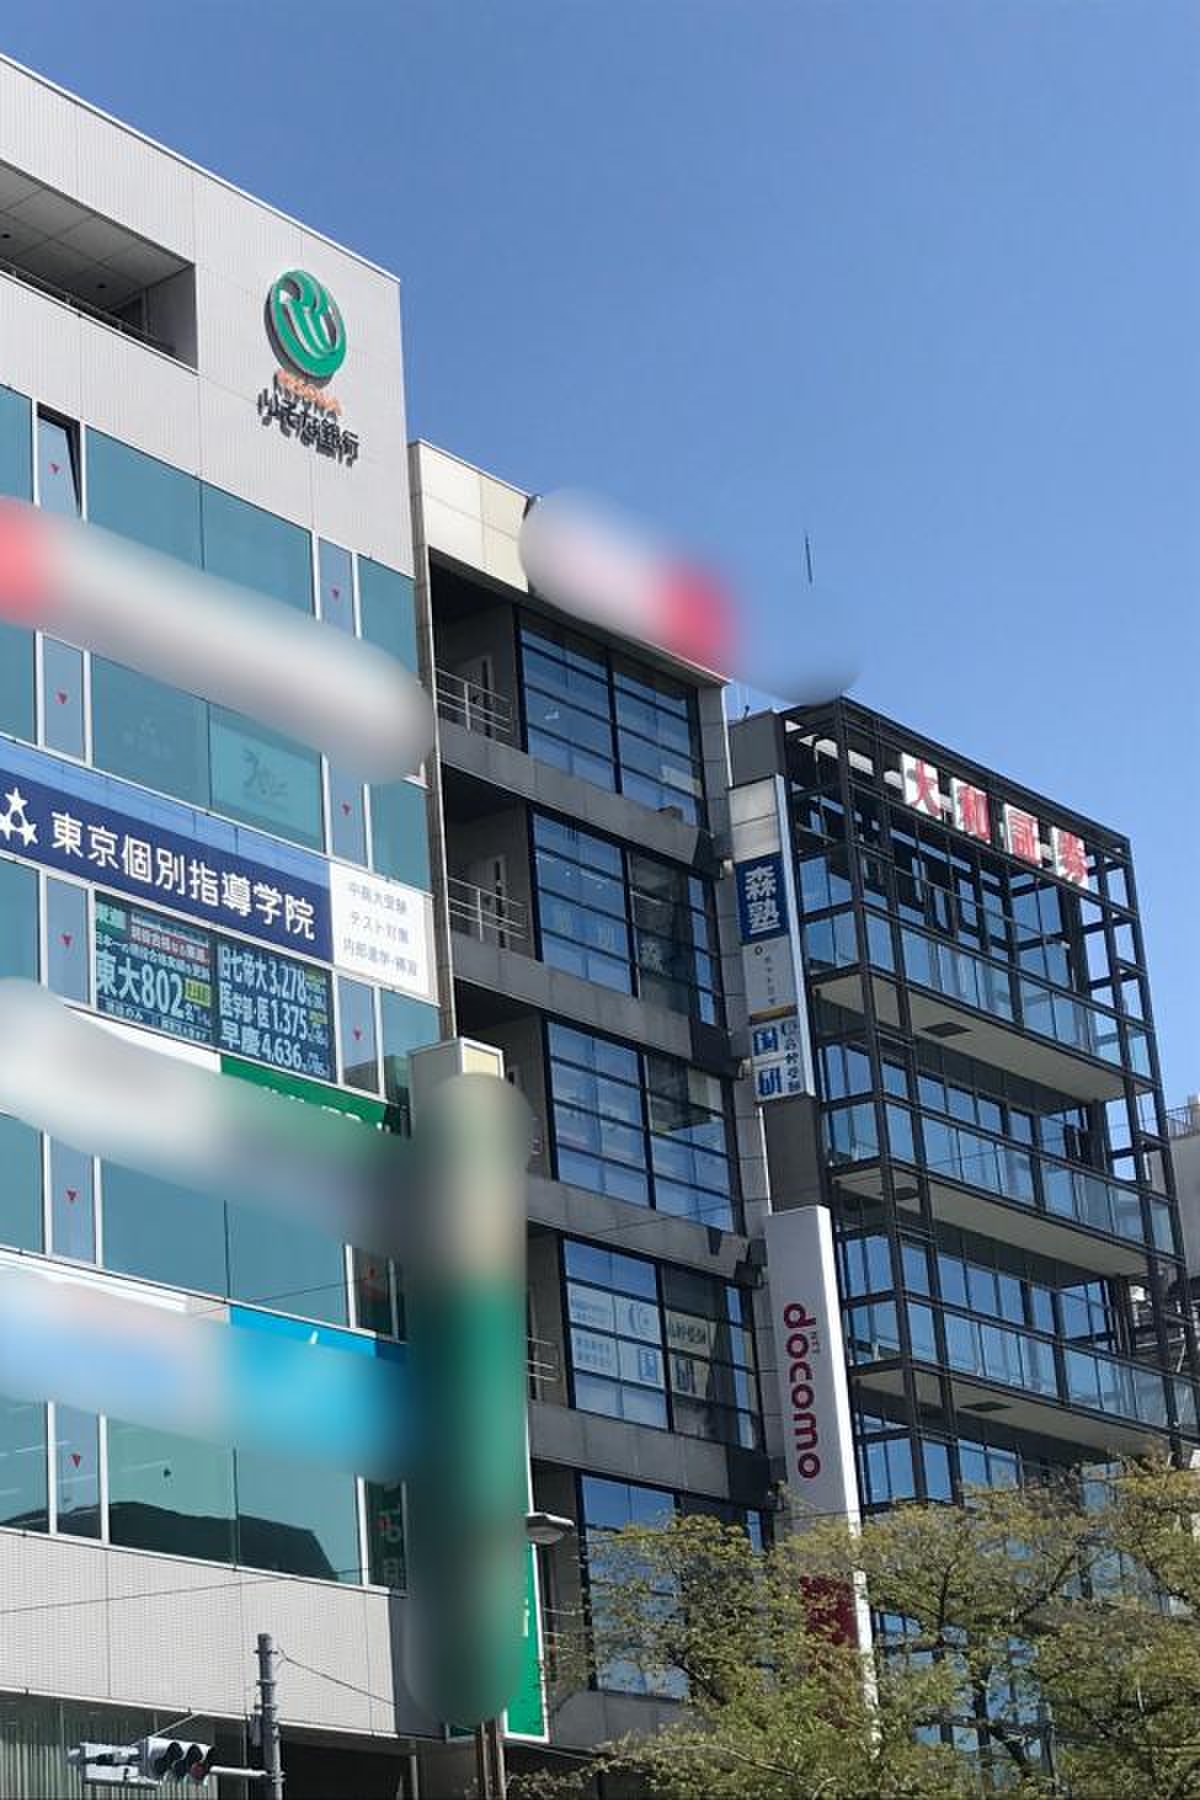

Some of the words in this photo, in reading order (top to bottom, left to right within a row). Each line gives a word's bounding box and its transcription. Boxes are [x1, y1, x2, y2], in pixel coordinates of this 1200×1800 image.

[256, 387, 360, 467] りそな銀行
[50, 811, 316, 941] 東京個別指導学院
[904, 755, 1090, 885] 大和証券
[744, 864, 781, 935] 森塾
[784, 1303, 821, 1479] docomo
